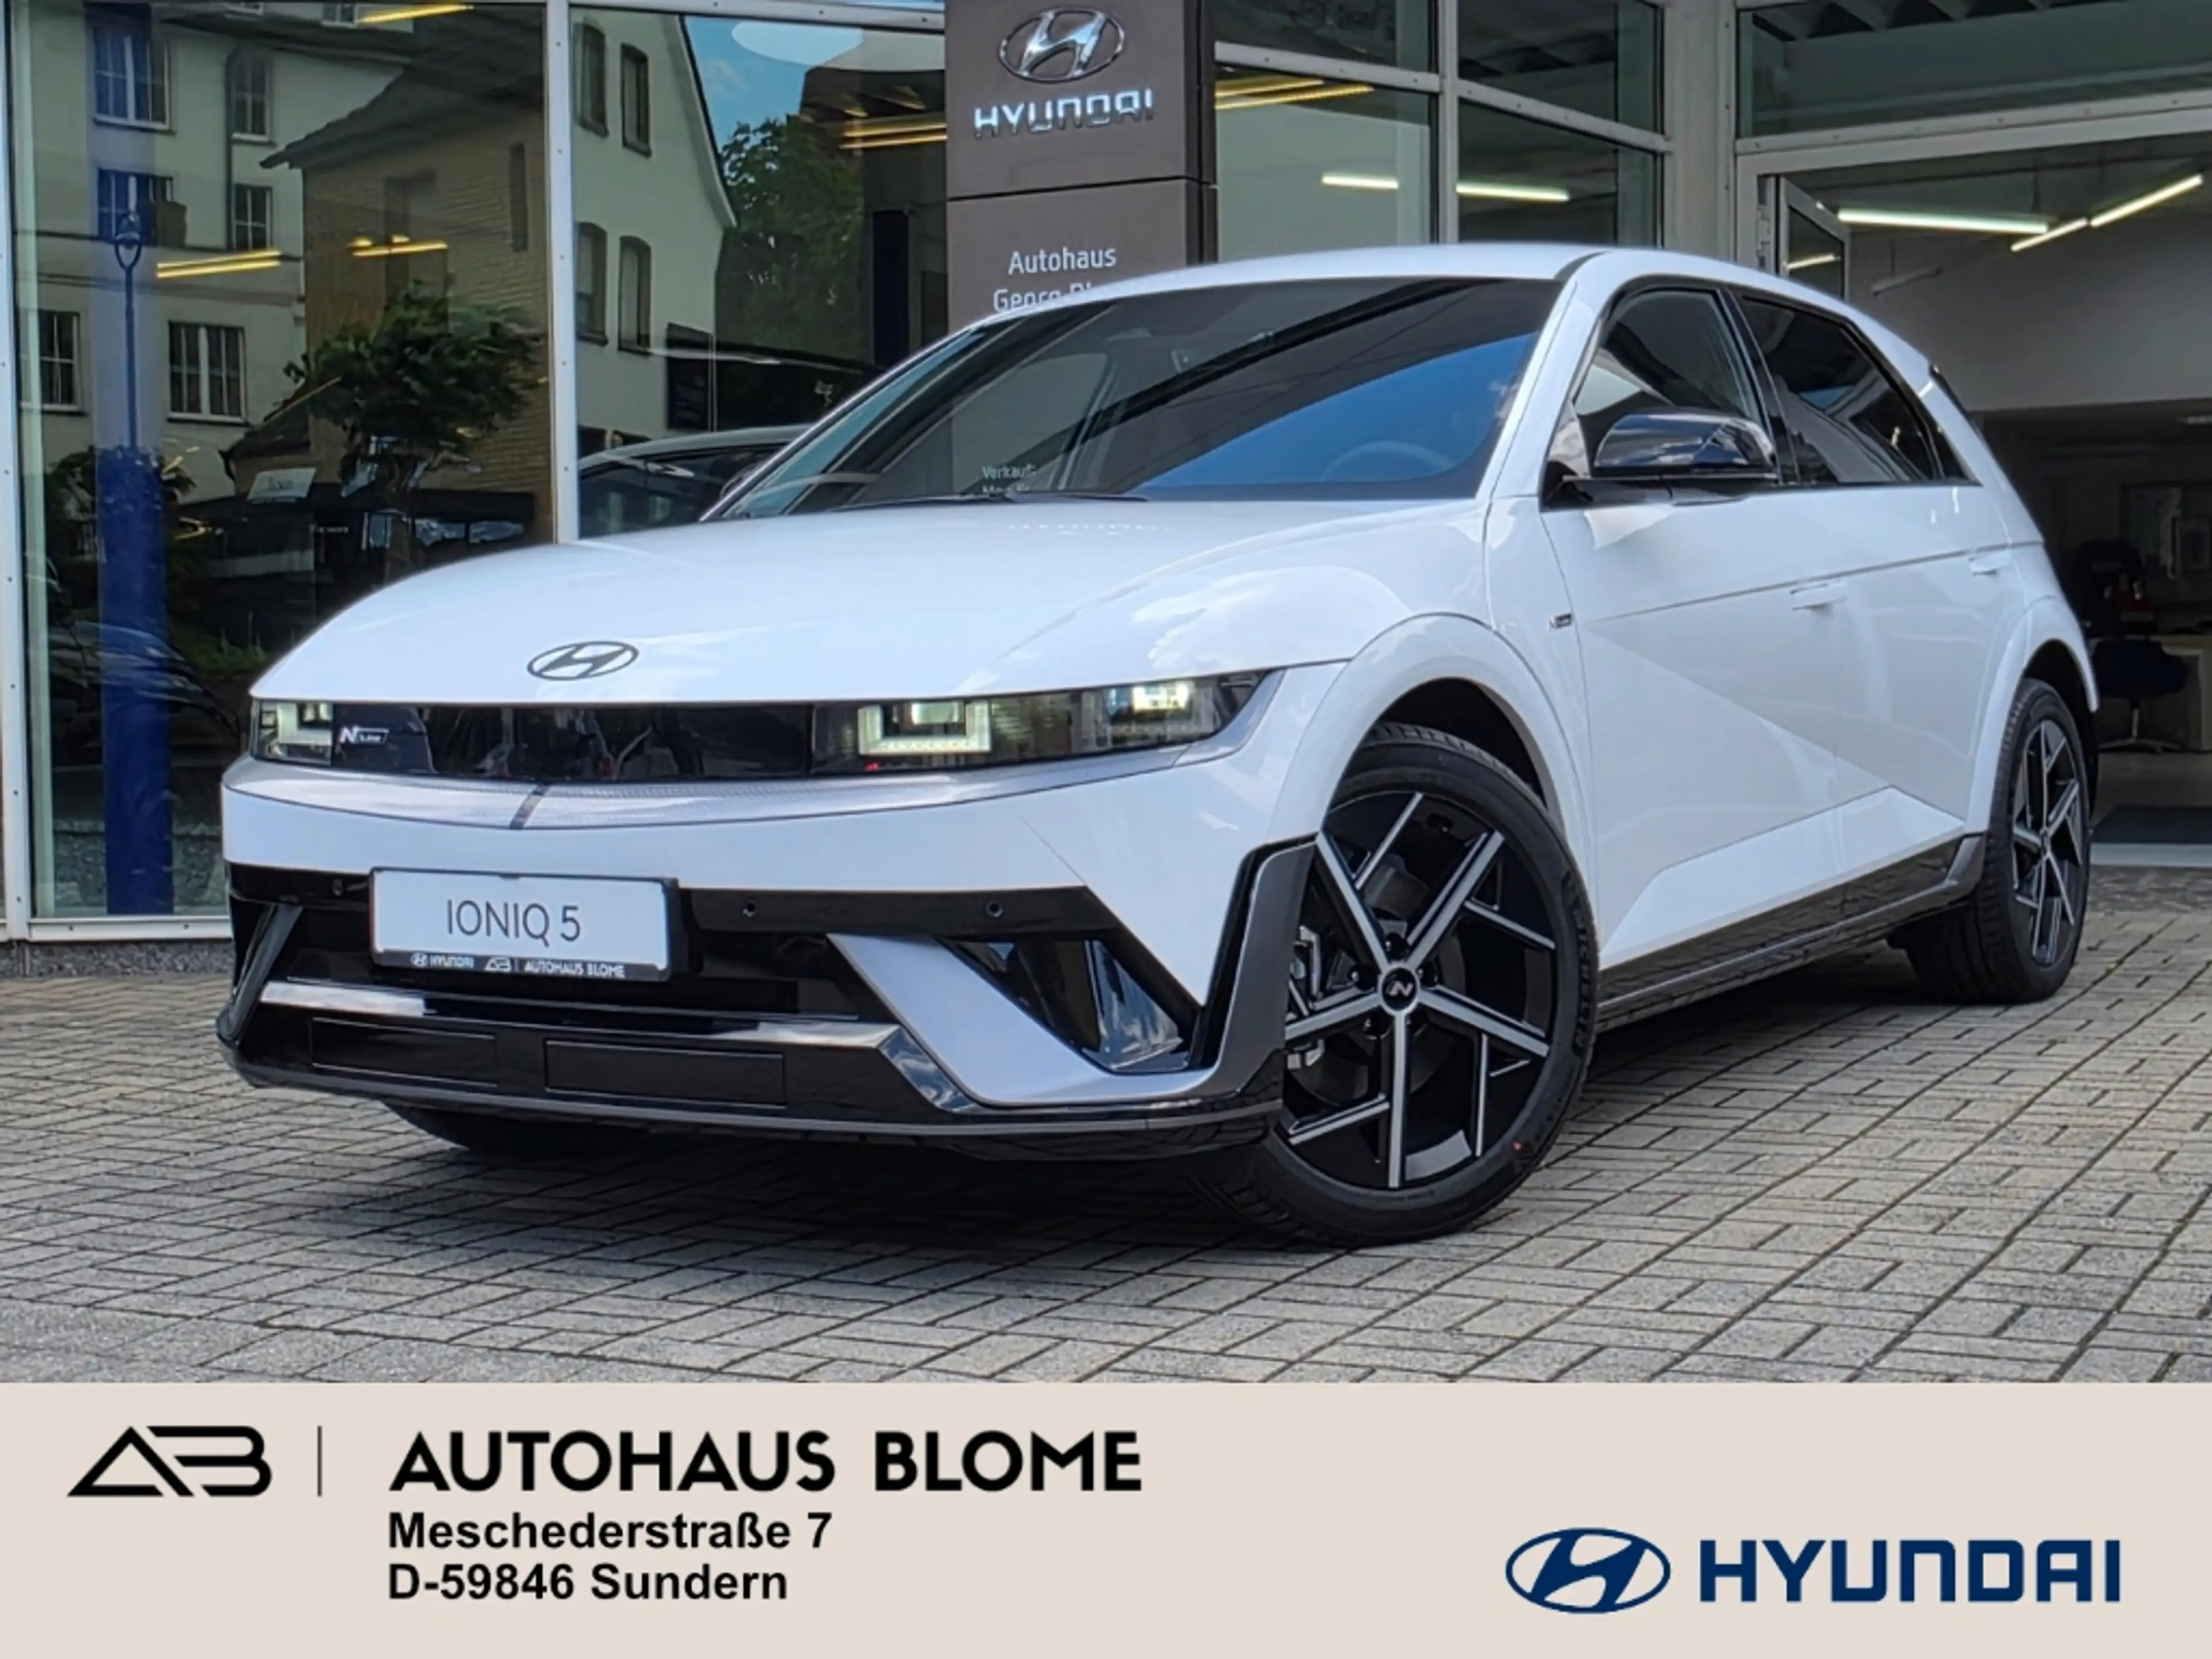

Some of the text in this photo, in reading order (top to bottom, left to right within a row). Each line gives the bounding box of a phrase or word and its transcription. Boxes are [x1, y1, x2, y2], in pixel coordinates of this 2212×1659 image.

[974, 88, 1154, 139] HYUNDAI
[1008, 248, 1116, 275] Autohaus
[447, 899, 581, 948] IONIQ 5
[430, 955, 474, 969] HYUNDAI
[524, 960, 584, 976] AUTOHAUS
[586, 963, 625, 979] BLOME
